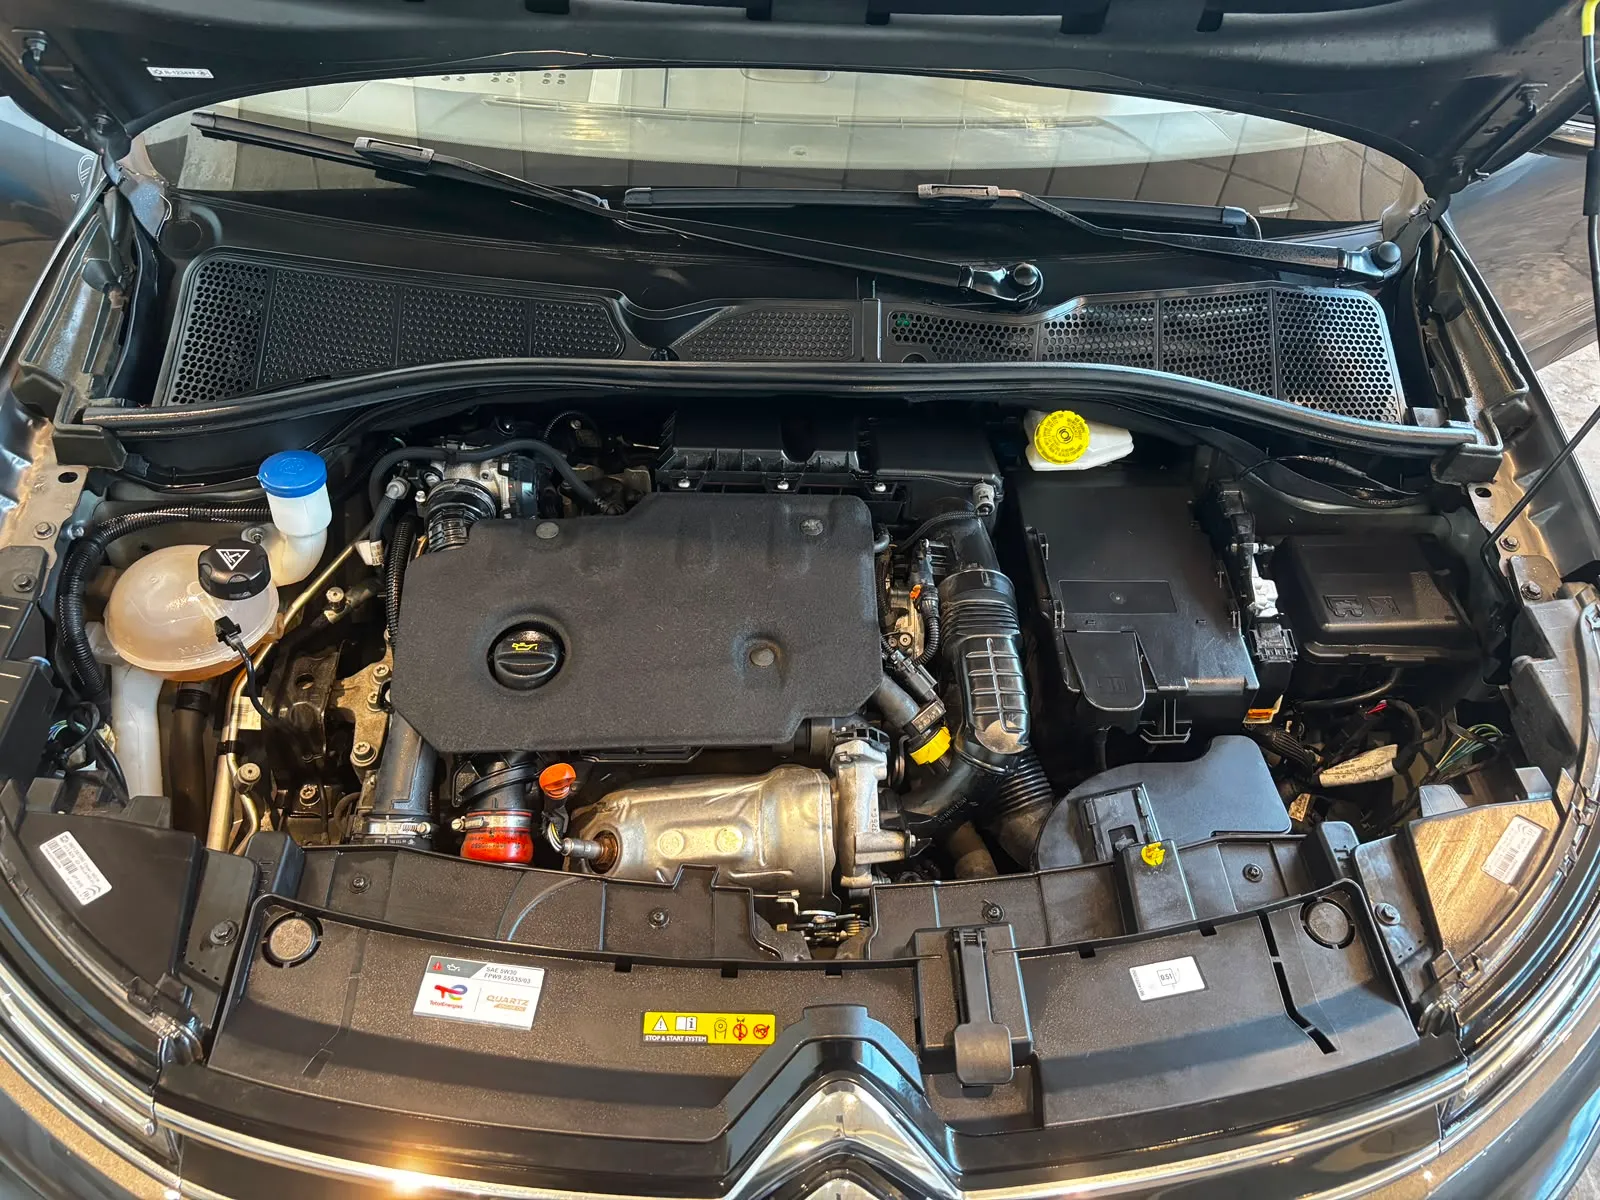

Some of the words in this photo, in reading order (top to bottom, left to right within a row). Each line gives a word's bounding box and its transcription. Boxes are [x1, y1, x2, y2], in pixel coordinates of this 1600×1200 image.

[486, 966, 499, 974] SAE
[500, 968, 517, 976] 5W30
[486, 995, 529, 1006] QUARTZ
